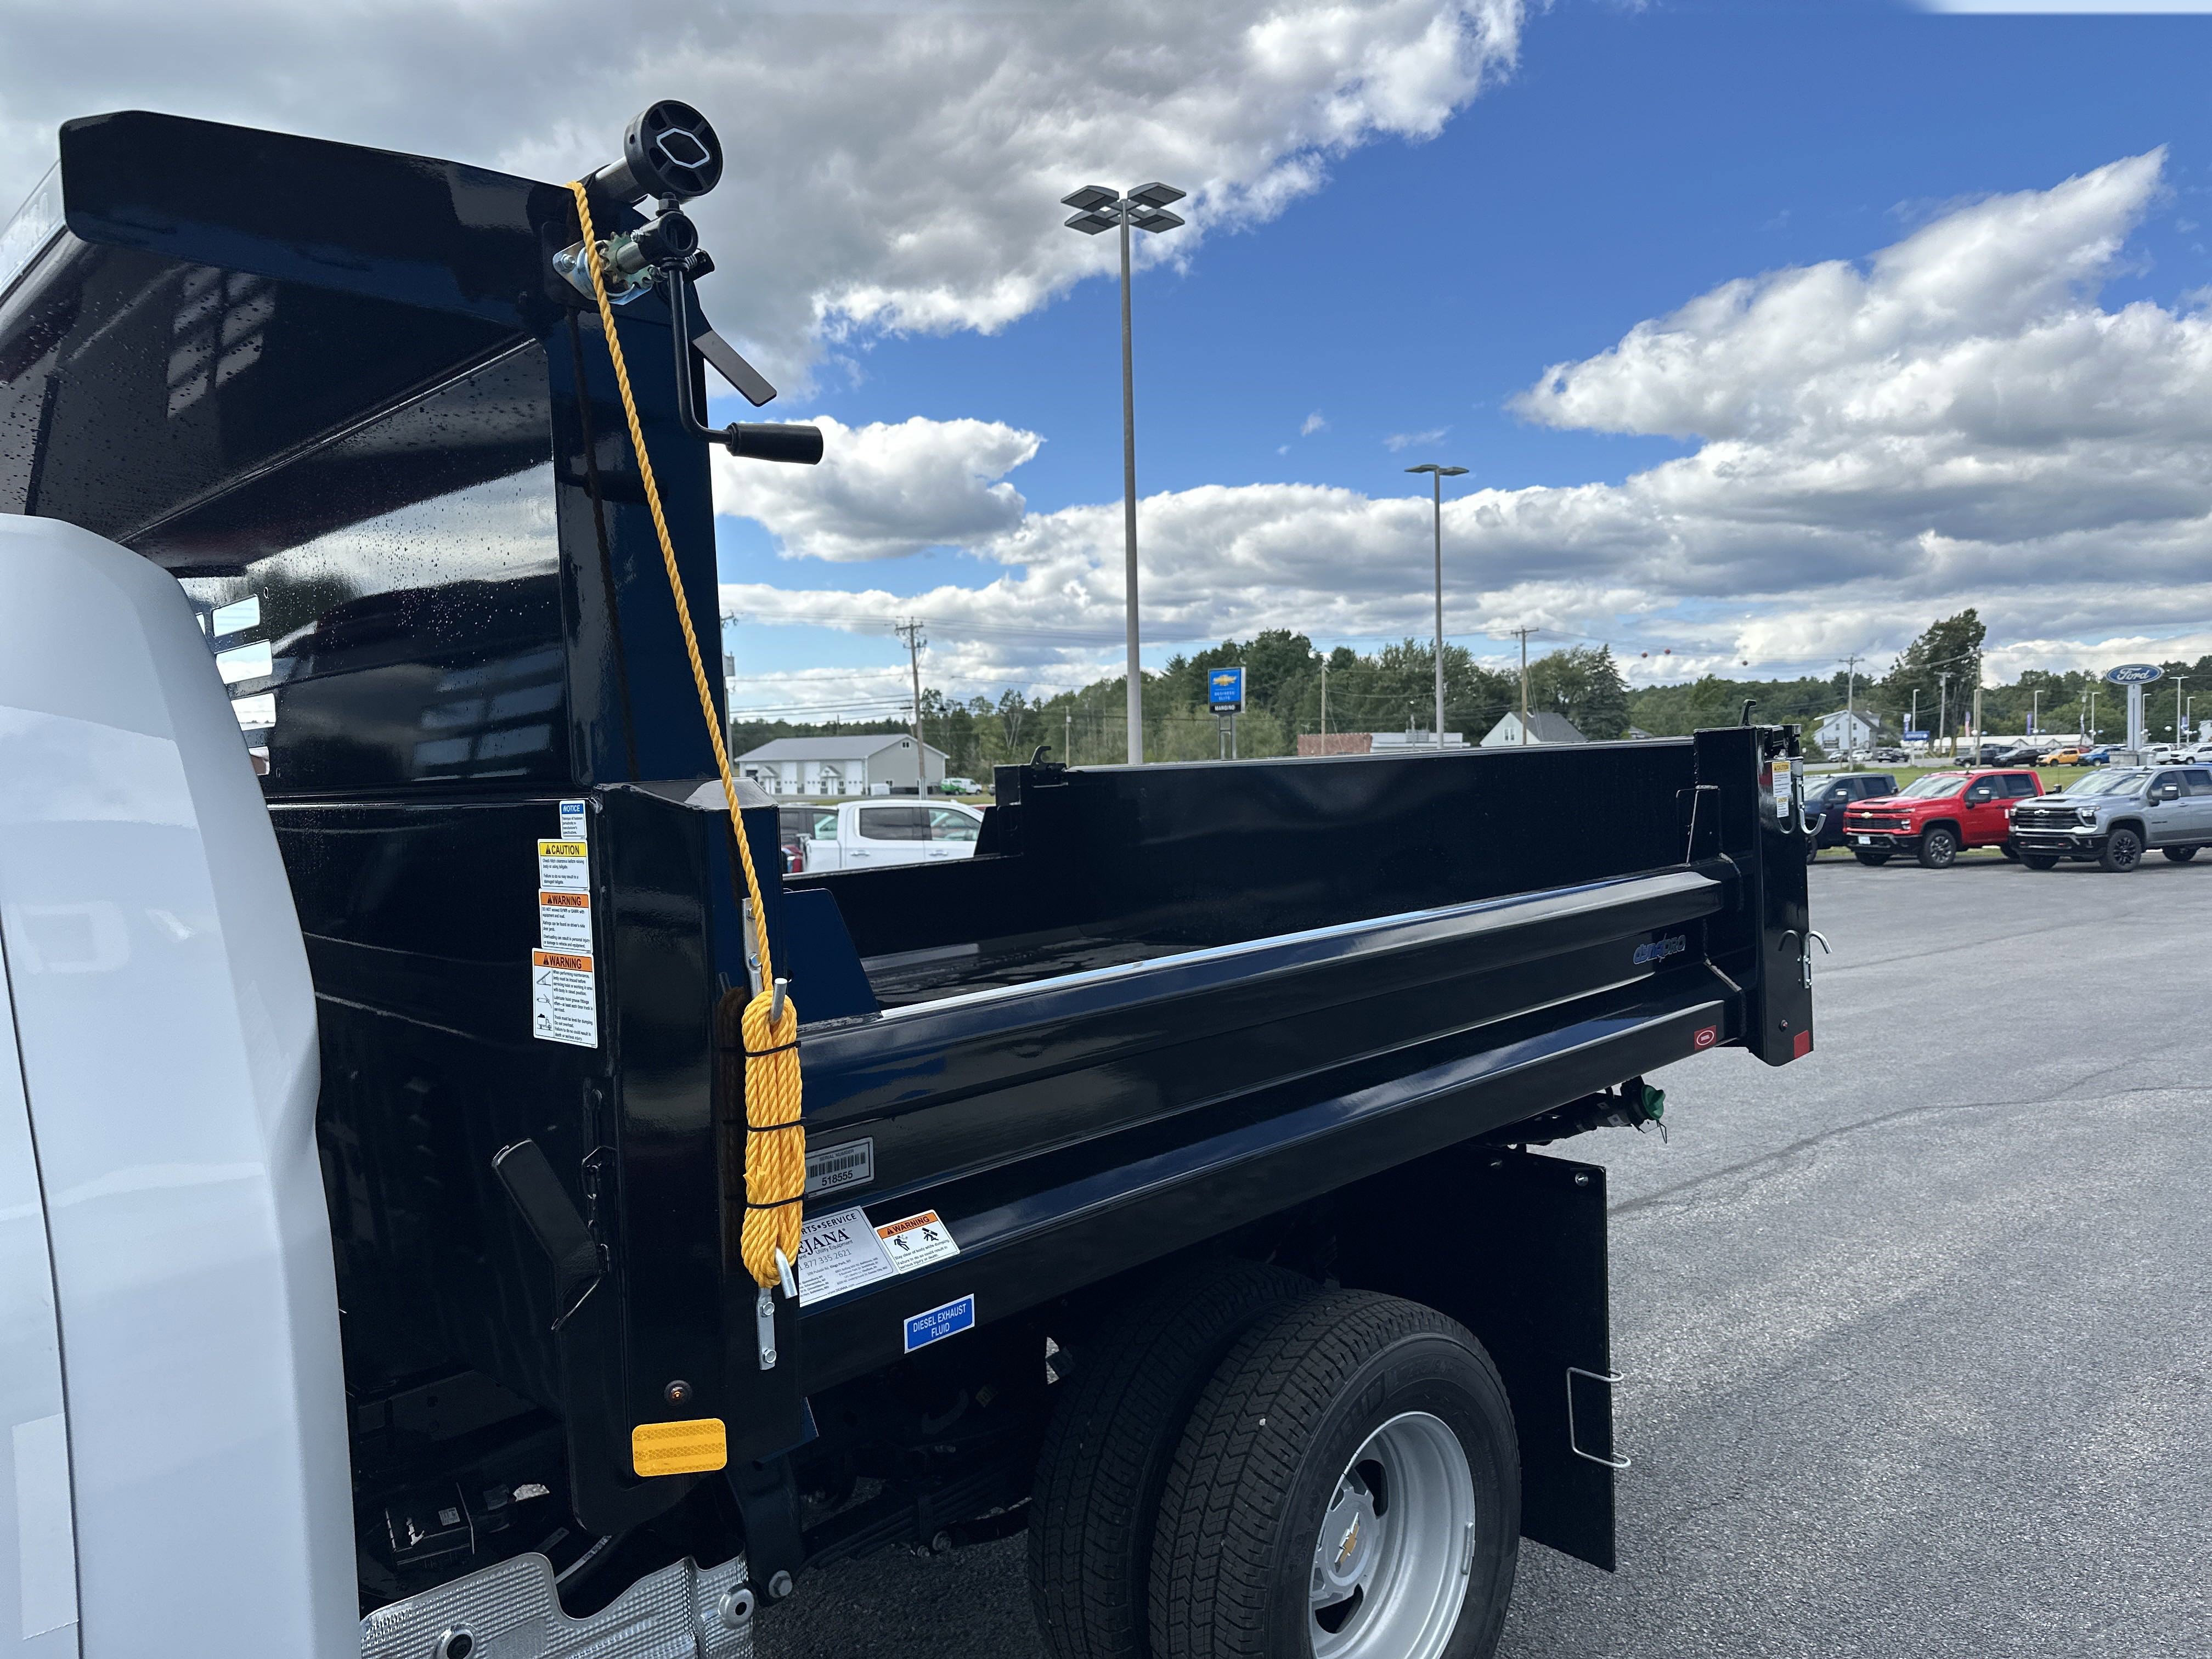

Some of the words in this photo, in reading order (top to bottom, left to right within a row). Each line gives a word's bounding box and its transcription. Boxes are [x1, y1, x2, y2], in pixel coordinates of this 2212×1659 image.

[2117, 668, 2150, 680] Ford
[563, 804, 580, 812] NOTICE
[551, 845, 580, 855] CAUTION
[552, 895, 582, 906] WARNING
[549, 956, 582, 969] WARNING
[822, 1170, 853, 1186] 518555
[893, 1216, 930, 1232] WARNING
[798, 1229, 850, 1255] EJANA
[913, 1316, 936, 1333] DIESEL
[938, 1304, 967, 1323] EXHAUST
[932, 1322, 950, 1338] FLUID
